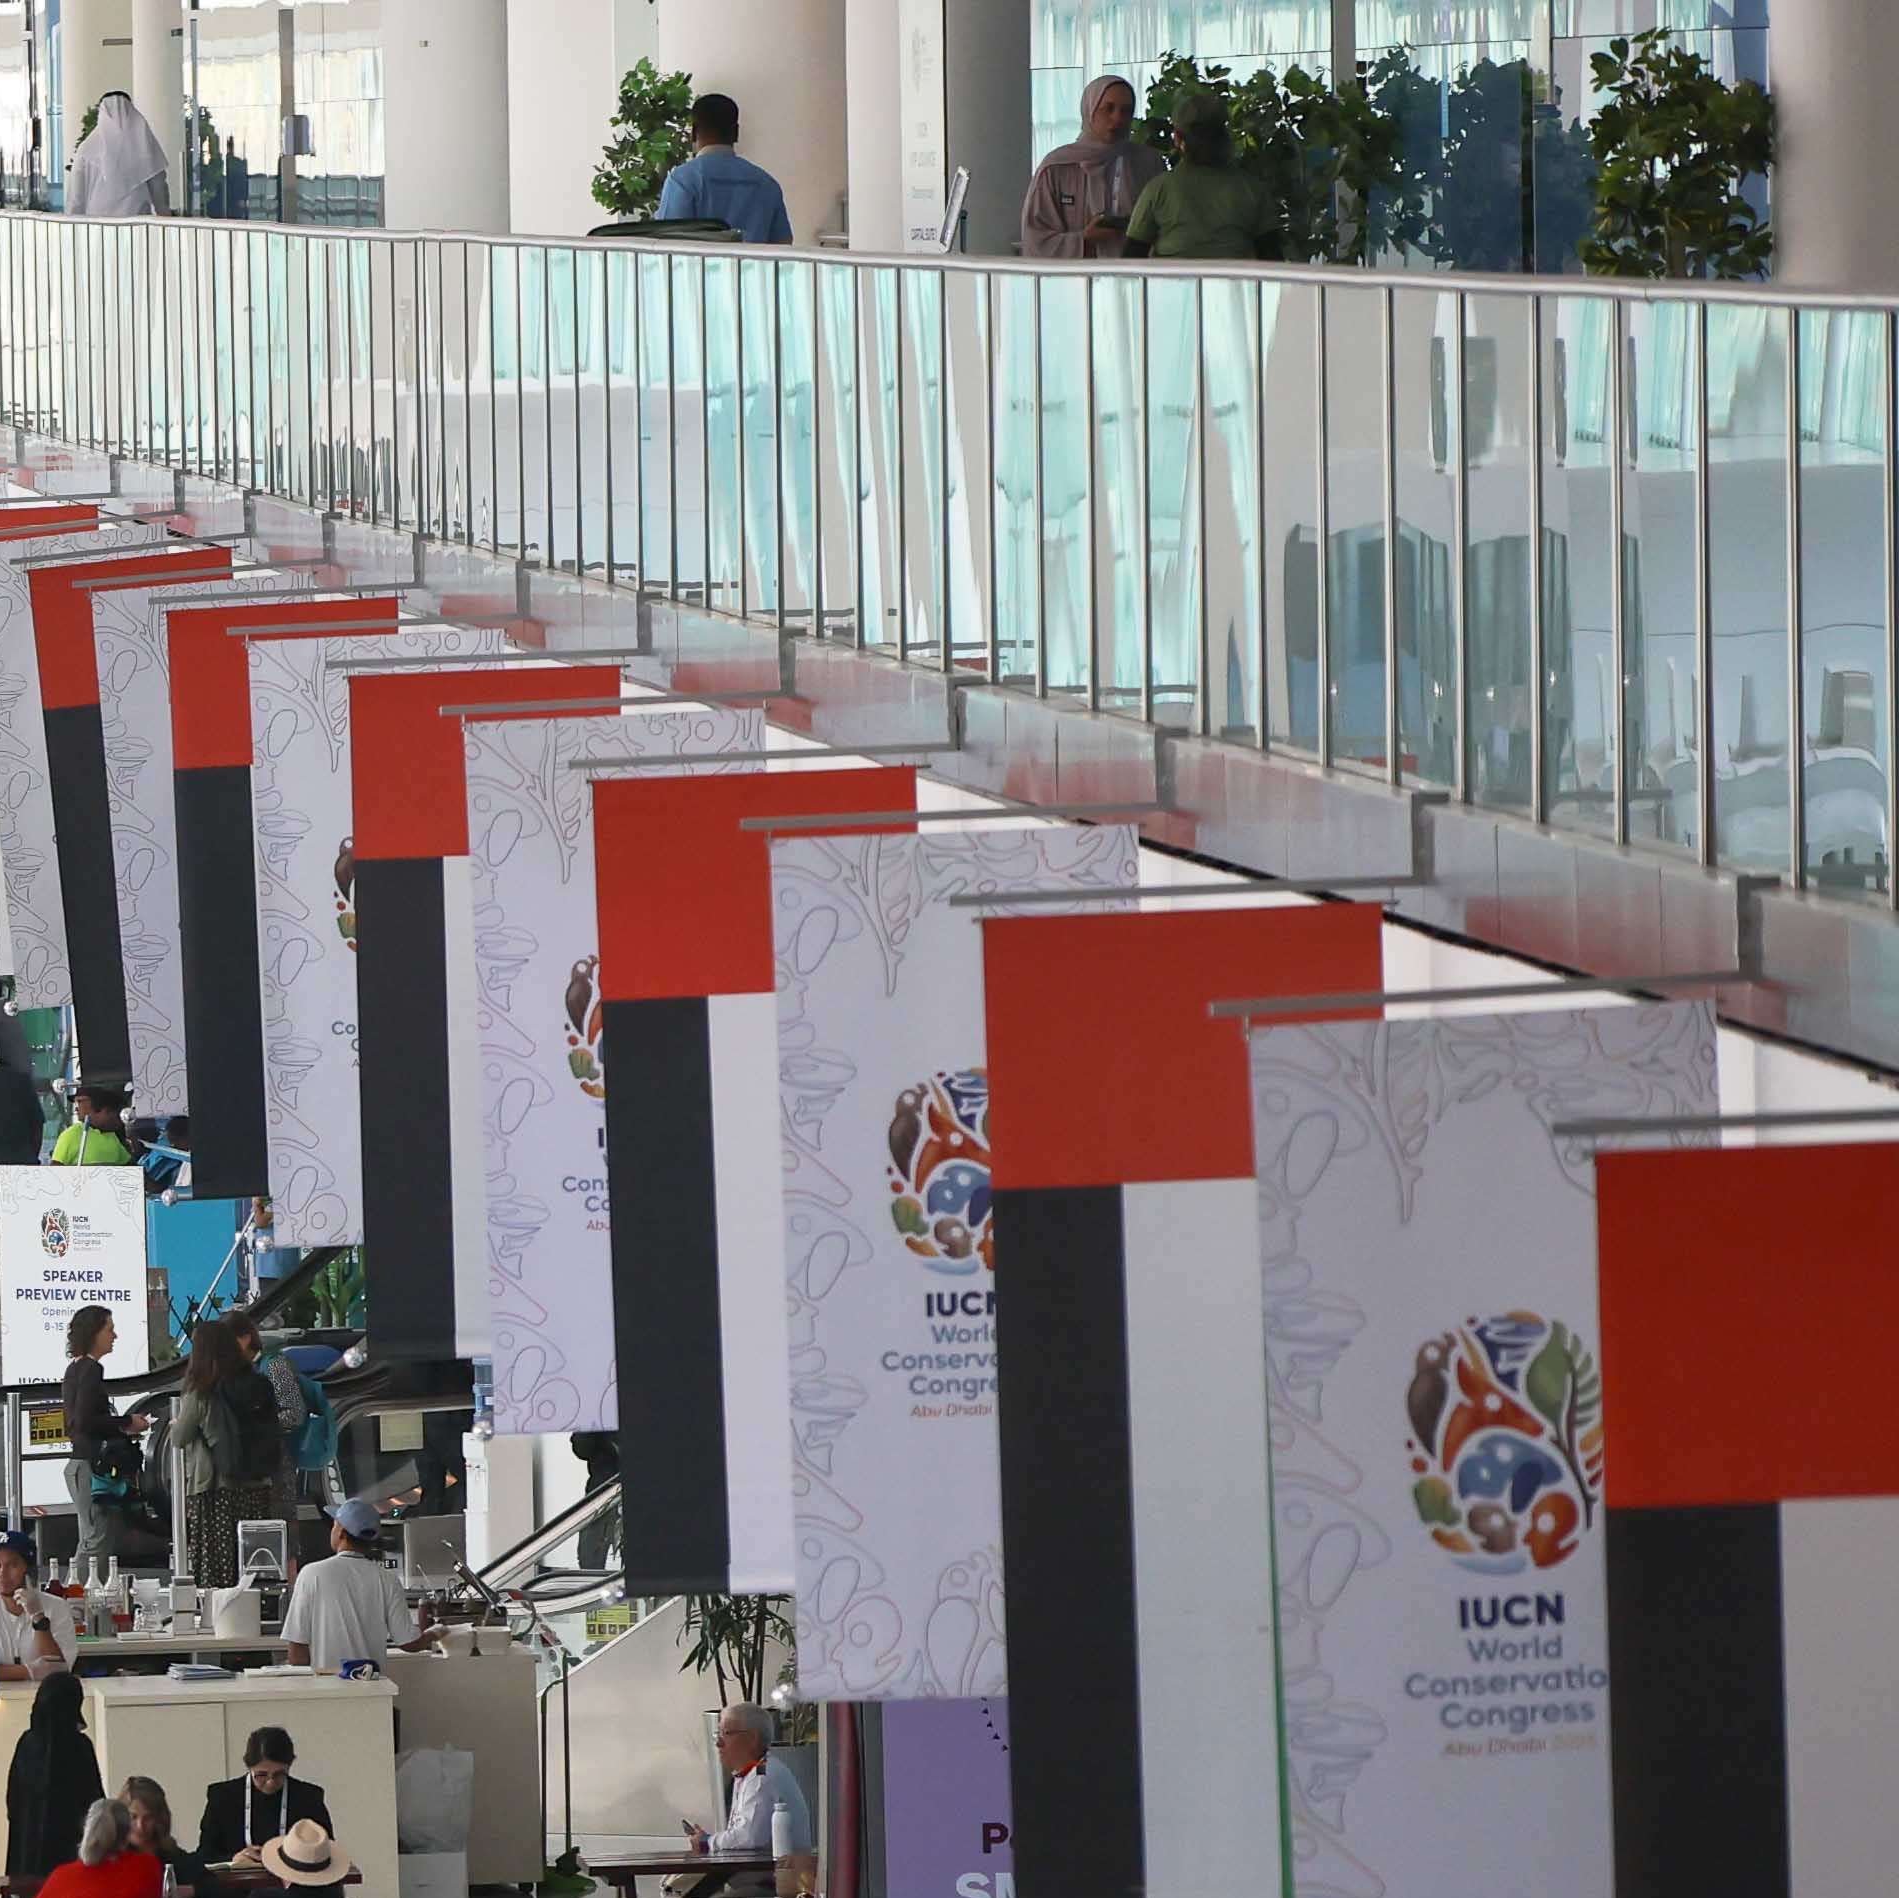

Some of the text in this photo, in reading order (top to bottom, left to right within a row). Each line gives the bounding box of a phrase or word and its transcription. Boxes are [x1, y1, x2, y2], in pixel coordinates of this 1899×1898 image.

[43, 1270, 103, 1282] SPEAKER
[16, 1289, 131, 1301] PREVIEW CENTRE
[42, 1307, 75, 1317] Openin
[45, 1322, 64, 1331] 8-15
[882, 1350, 1001, 1371] Conserv
[910, 1402, 992, 1418] Abu Dhabi
[1458, 1593, 1565, 1630] IUCN
[1466, 1637, 1563, 1663] World
[1405, 1665, 1610, 1700] Conservatio
[1440, 1700, 1596, 1735] Congress
[1442, 1740, 1482, 1758] Abu
[1487, 1738, 1546, 1754] Dhabi
